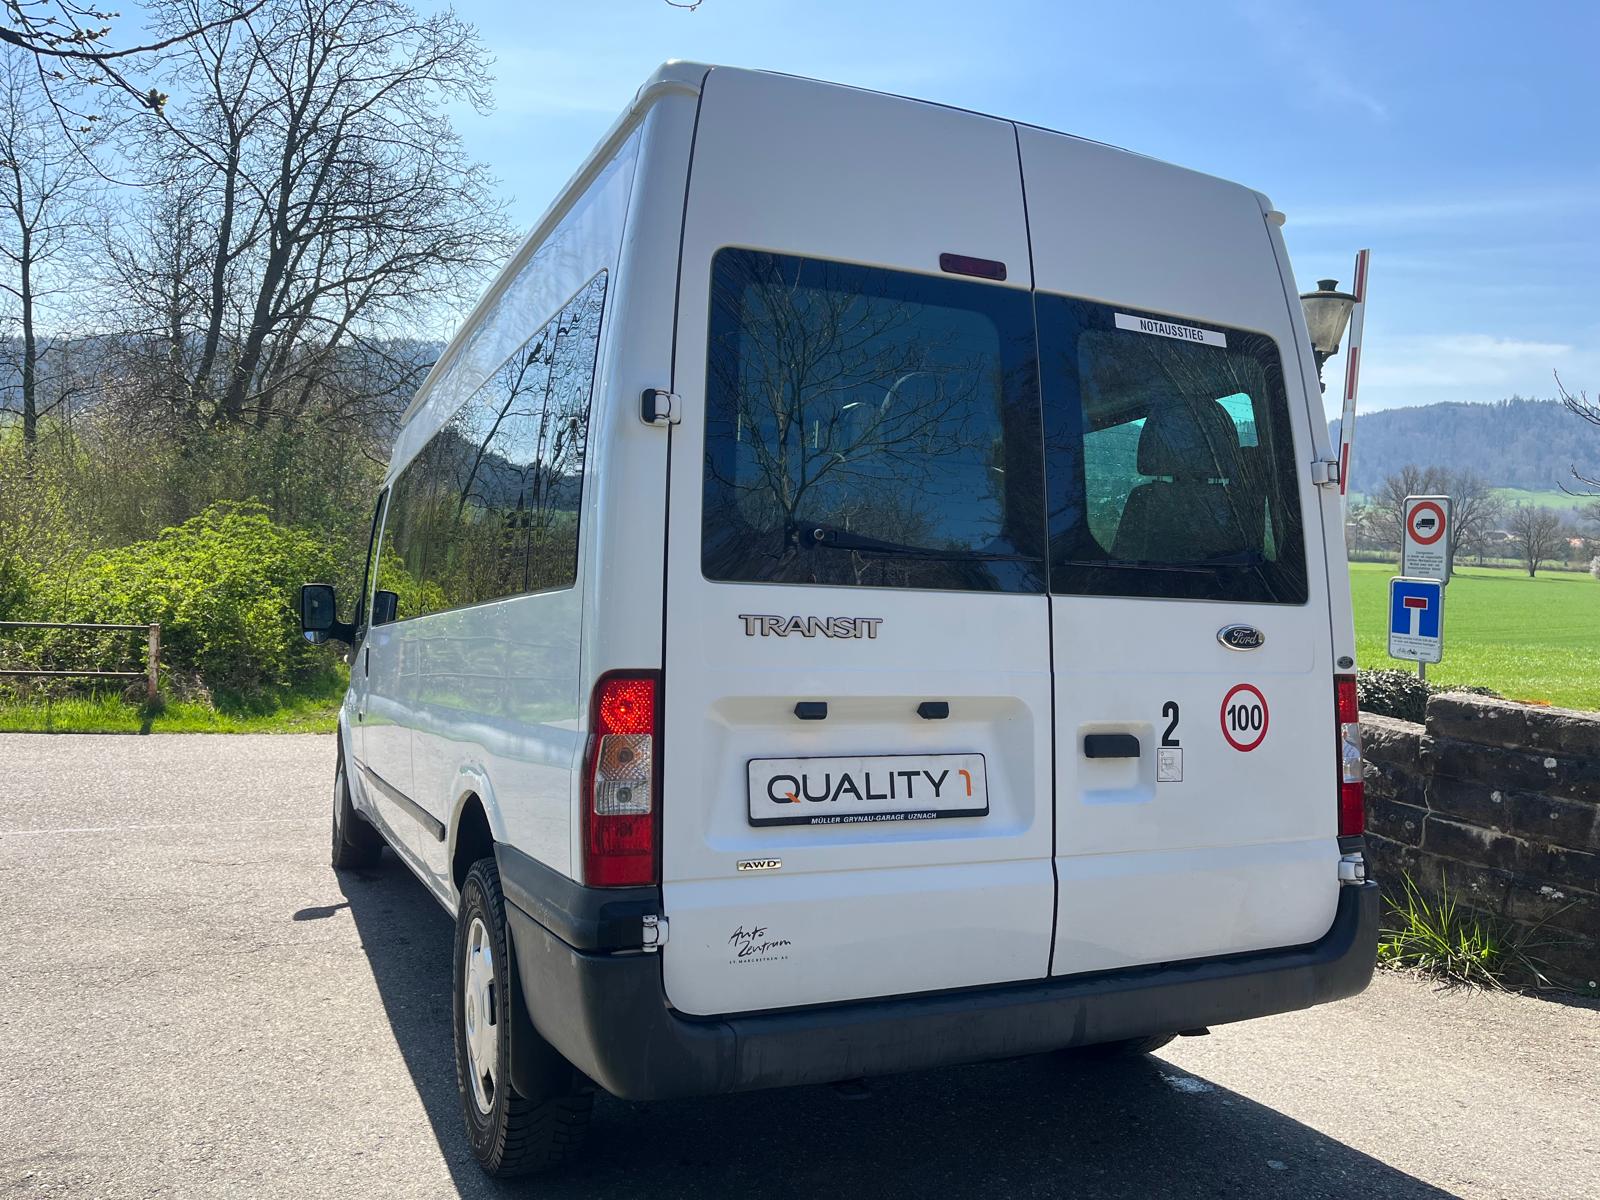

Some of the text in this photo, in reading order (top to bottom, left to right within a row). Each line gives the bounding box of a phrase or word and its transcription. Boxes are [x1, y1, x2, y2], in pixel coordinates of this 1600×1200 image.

[1140, 320, 1204, 341] NOTAUSSTIEG
[738, 614, 883, 639] TRANSIT
[1231, 629, 1258, 644] Ford
[1161, 700, 1180, 747] 2
[1227, 704, 1263, 731] 100
[767, 769, 972, 804] QUALITY 1
[811, 812, 937, 825] MÜLLER GRYNAU-GARAGE UZNACH
[743, 860, 777, 869] AWD
[728, 925, 768, 947] Auto
[738, 939, 791, 957] Zentrum
